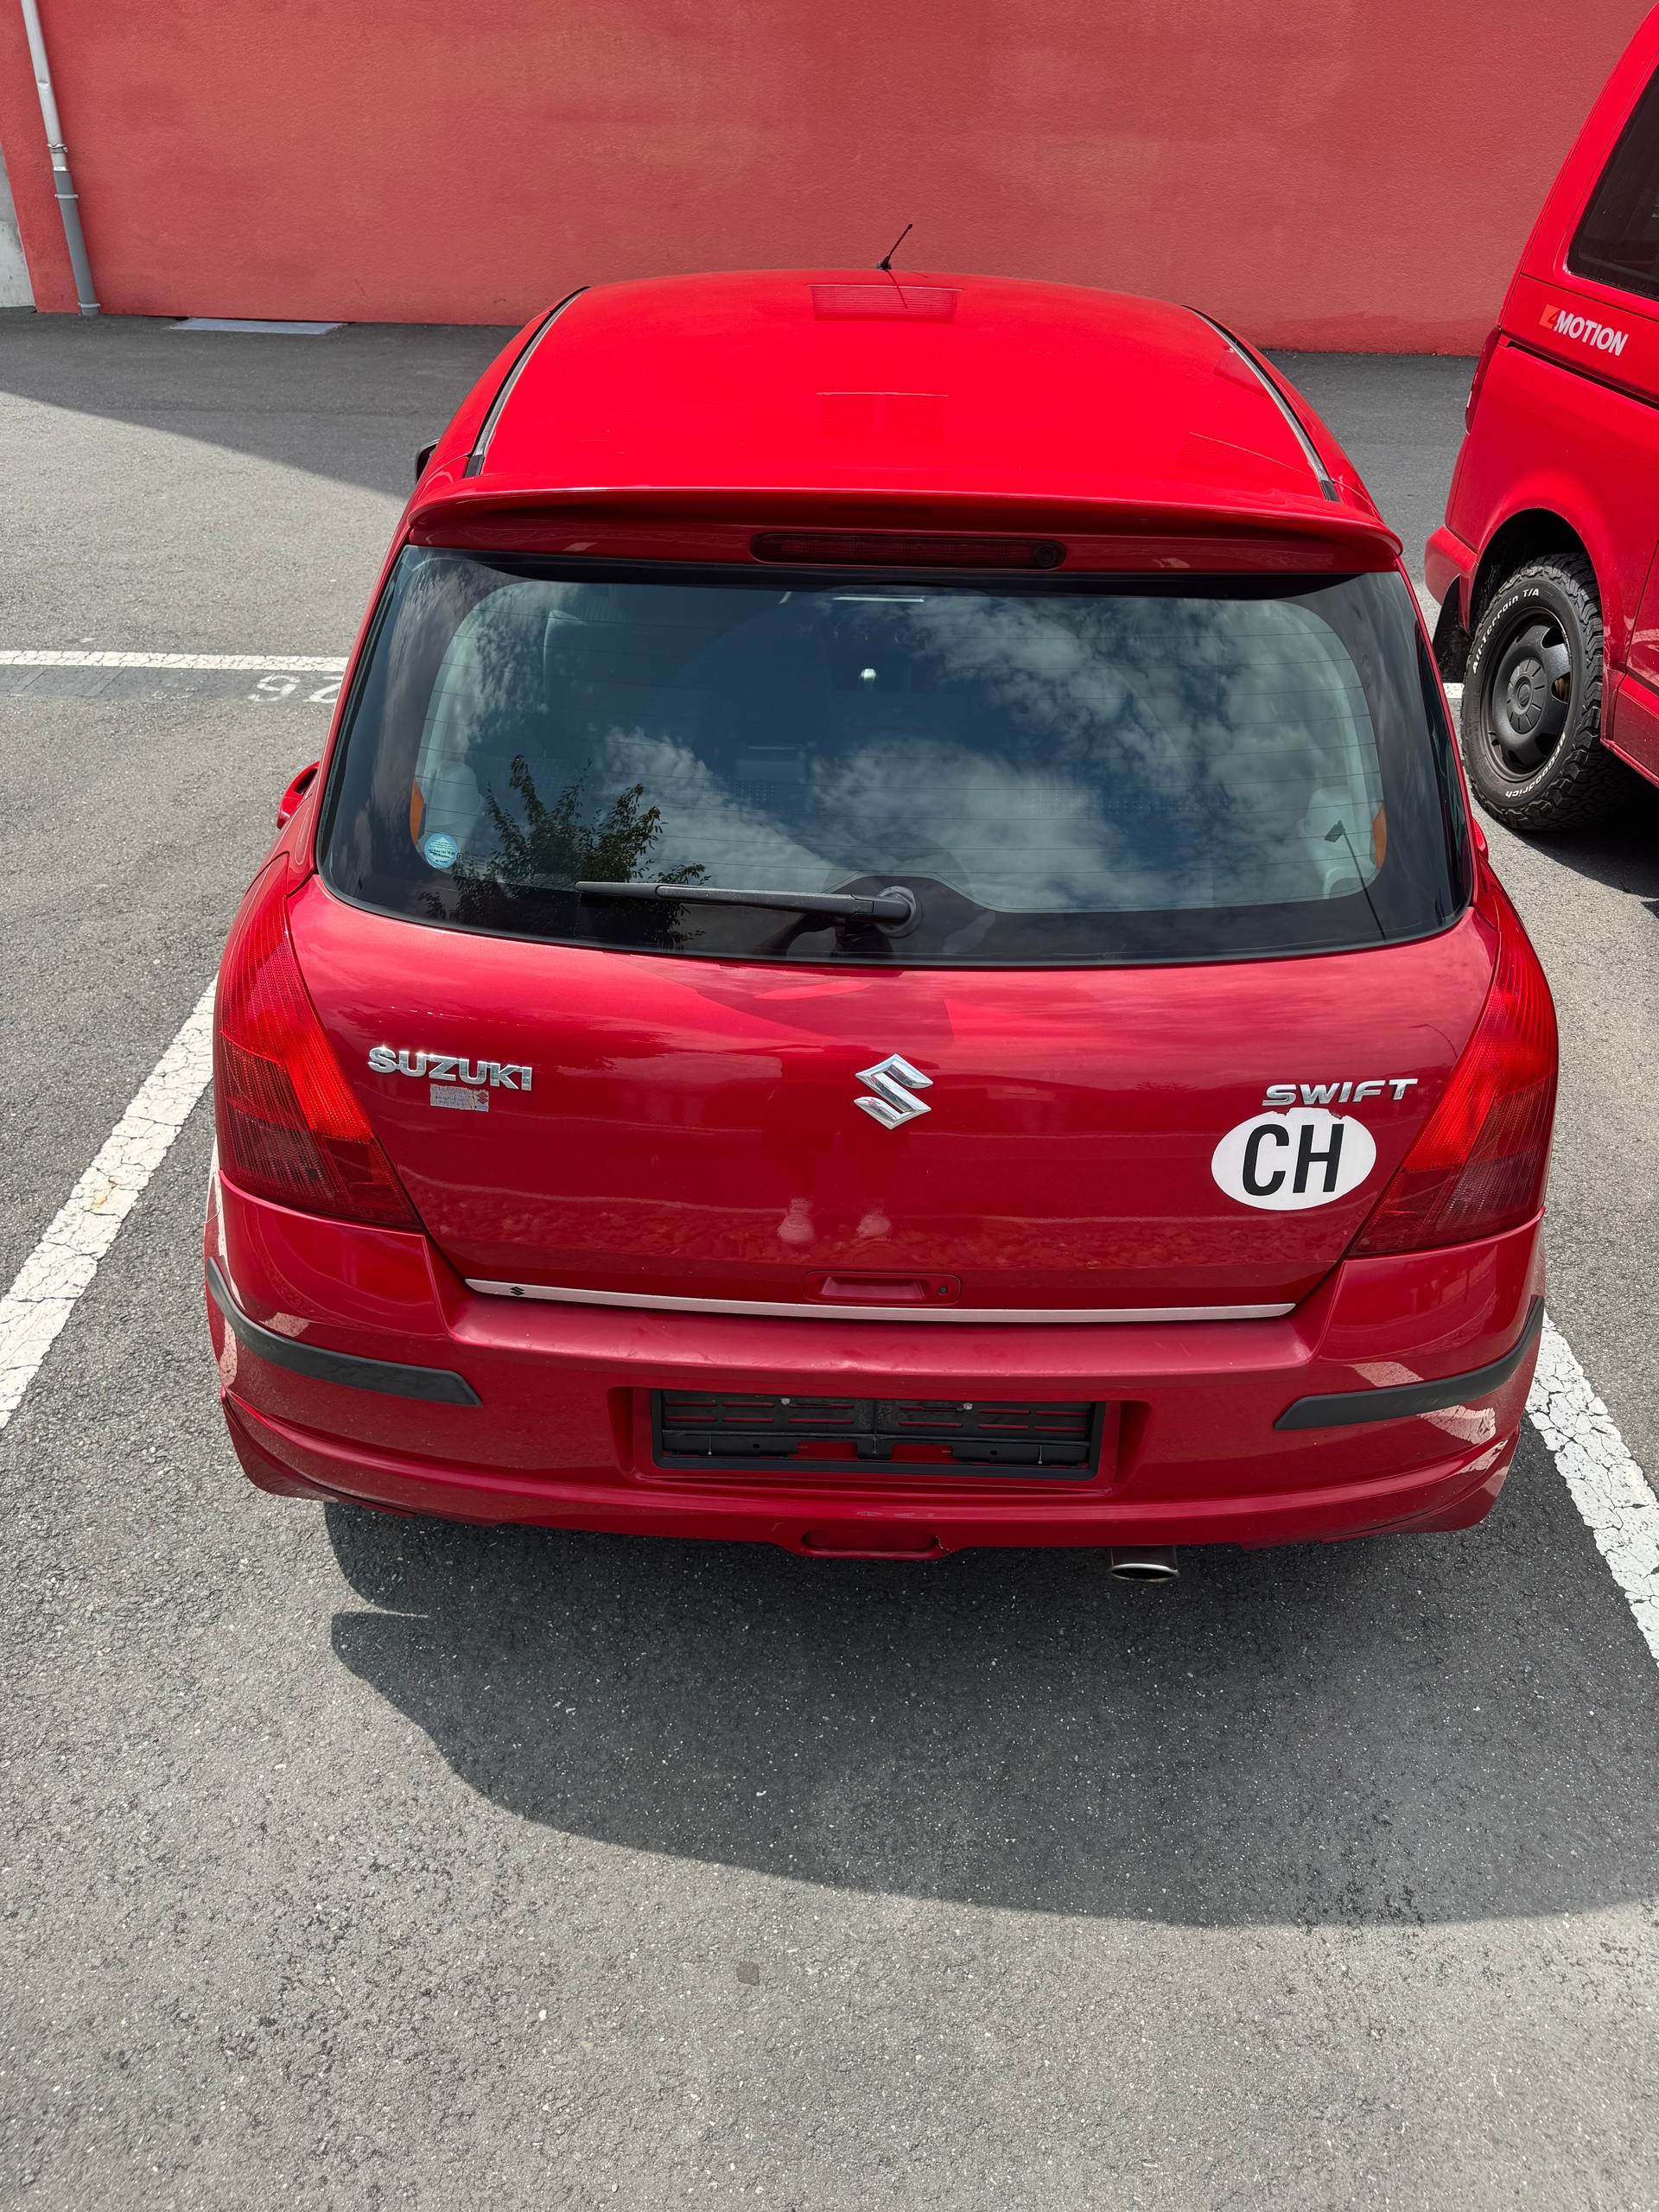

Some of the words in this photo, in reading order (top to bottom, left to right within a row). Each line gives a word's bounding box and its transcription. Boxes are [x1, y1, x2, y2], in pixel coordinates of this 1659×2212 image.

[1472, 595, 1518, 674] All-Terrain
[1523, 588, 1539, 597] T/A
[368, 1046, 532, 1091] SUZUKI
[1262, 1078, 1418, 1106] SWIFT
[1243, 1123, 1344, 1196] CH
